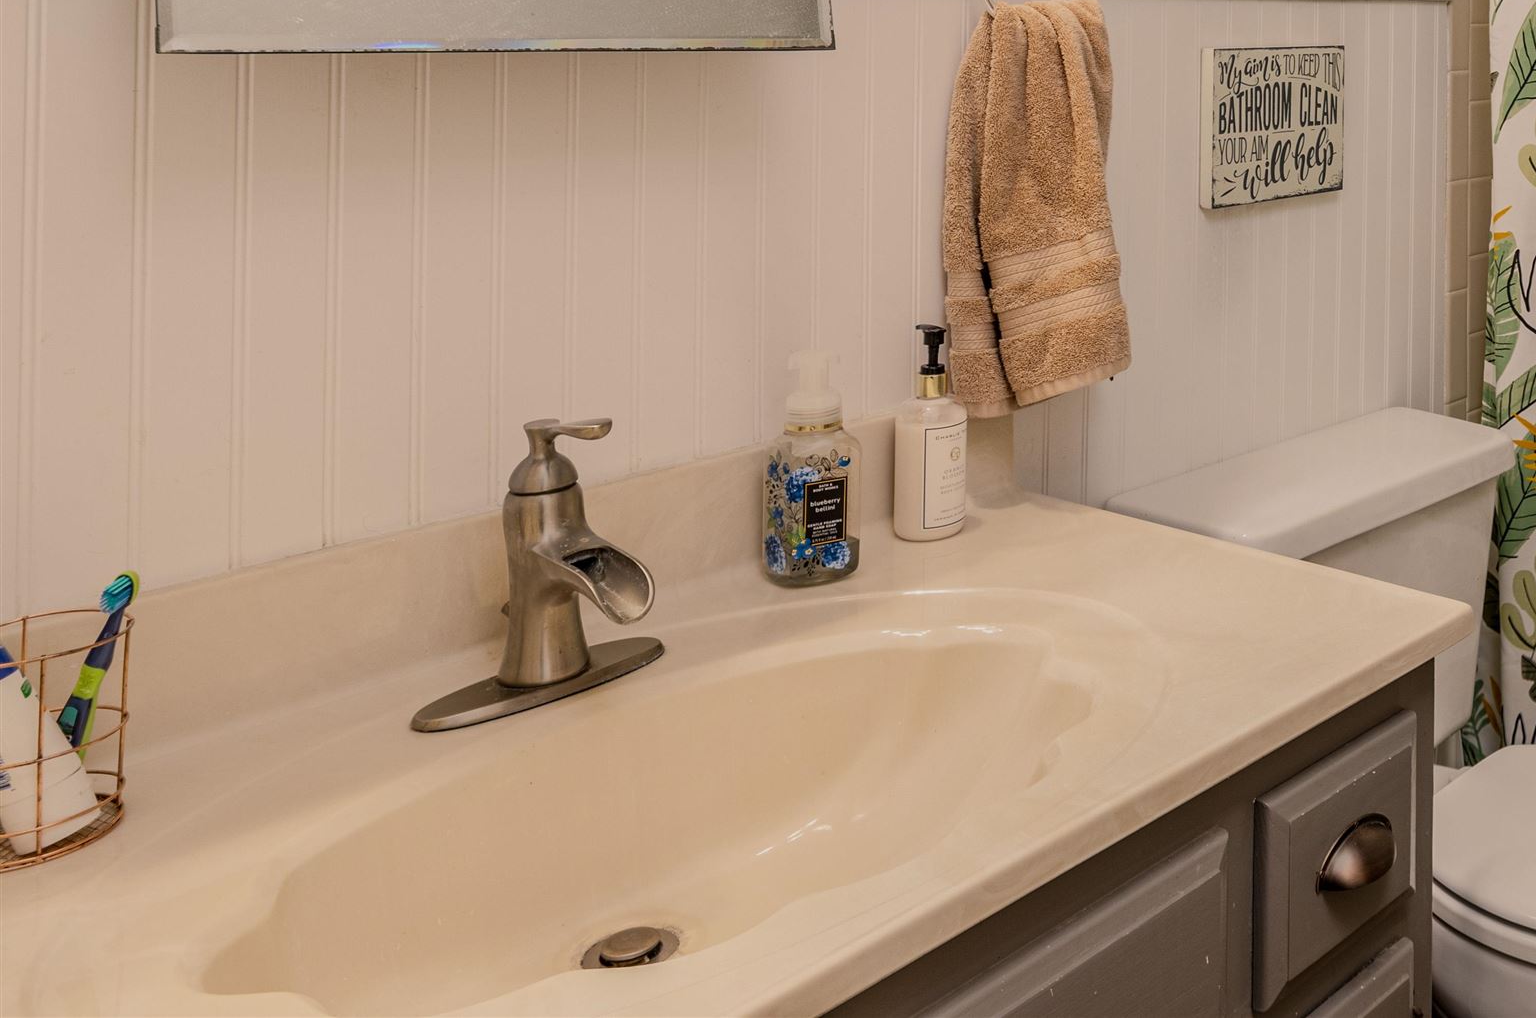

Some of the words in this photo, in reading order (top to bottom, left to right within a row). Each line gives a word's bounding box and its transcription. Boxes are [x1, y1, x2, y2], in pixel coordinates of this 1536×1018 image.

[1218, 54, 1243, 94] My
[1244, 56, 1270, 81] aim
[1271, 54, 1281, 77] is
[1284, 54, 1295, 74] TO
[1298, 53, 1320, 78] KEEP
[1322, 52, 1341, 92] THIS
[1218, 82, 1292, 135] BATHROOM
[1299, 83, 1338, 127] CLEAN
[1218, 136, 1247, 166] YOUR
[1249, 135, 1269, 162] AIM
[1234, 139, 1292, 199] will
[1292, 127, 1337, 185] help
[810, 498, 841, 507] blueberry
[815, 505, 836, 513] bellini
